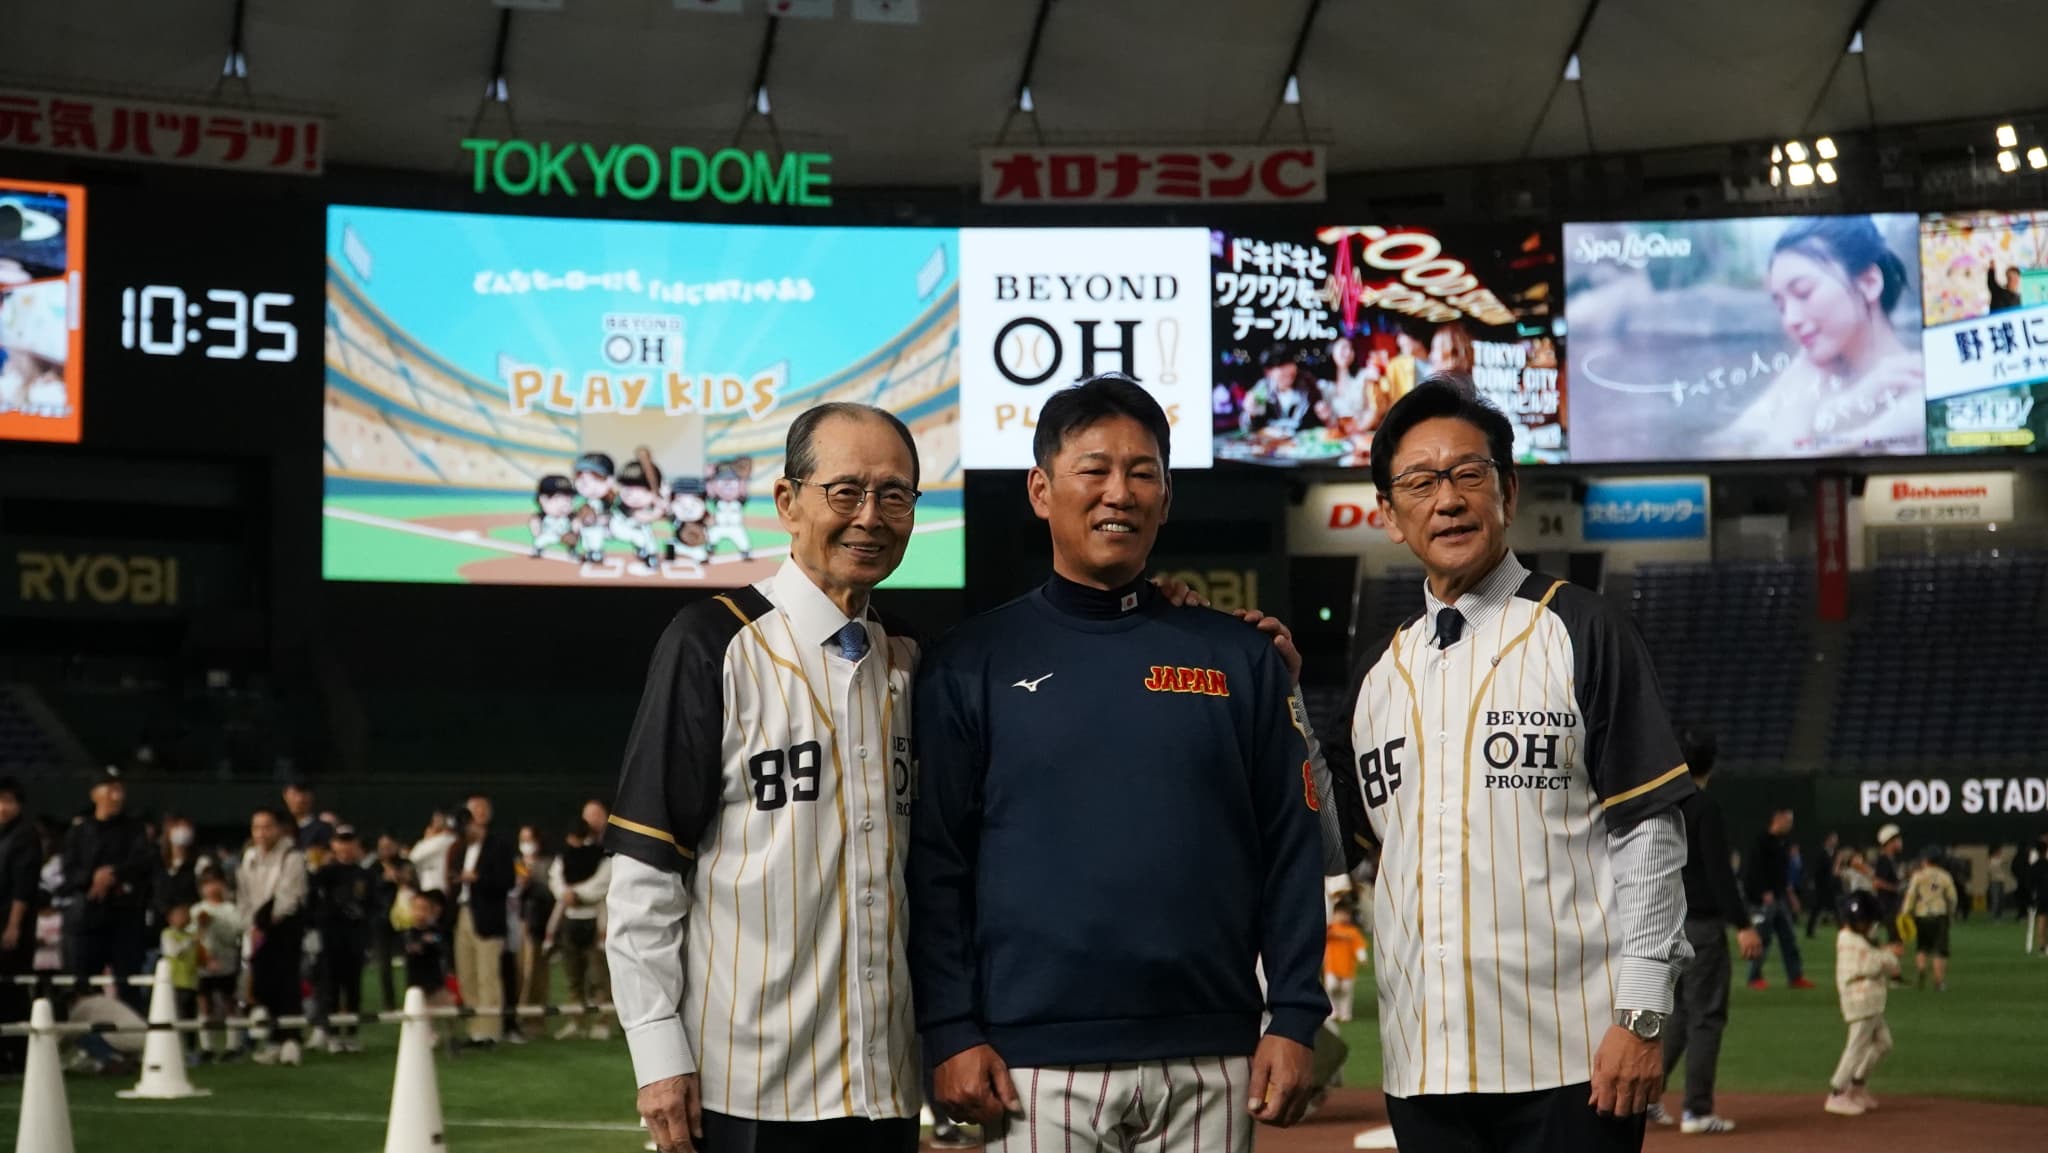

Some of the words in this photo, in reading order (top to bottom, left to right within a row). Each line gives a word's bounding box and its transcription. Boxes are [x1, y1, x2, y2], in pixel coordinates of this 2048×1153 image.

[0, 96, 320, 170] 元気ハツラツ!
[462, 139, 661, 199] TOKYO
[669, 147, 833, 208] DOME
[990, 149, 1317, 200] オロナミンC
[1231, 237, 1327, 280] ドキドキと
[995, 274, 1178, 301] BEYOND
[121, 284, 298, 363] 10:35
[1231, 306, 1338, 341] テーブルに。
[513, 370, 647, 410] PLAY
[667, 372, 777, 414] KIDS
[1523, 367, 1558, 392] CITY
[17, 552, 179, 604] RYOBI
[1144, 665, 1230, 697] JAPAN
[1485, 710, 1577, 727] BEYOND
[750, 740, 822, 811] 89
[1359, 737, 1406, 810] 85
[1484, 774, 1572, 791] PROJECT
[1860, 780, 1951, 816] FOOD
[1961, 777, 2048, 814] STAD
